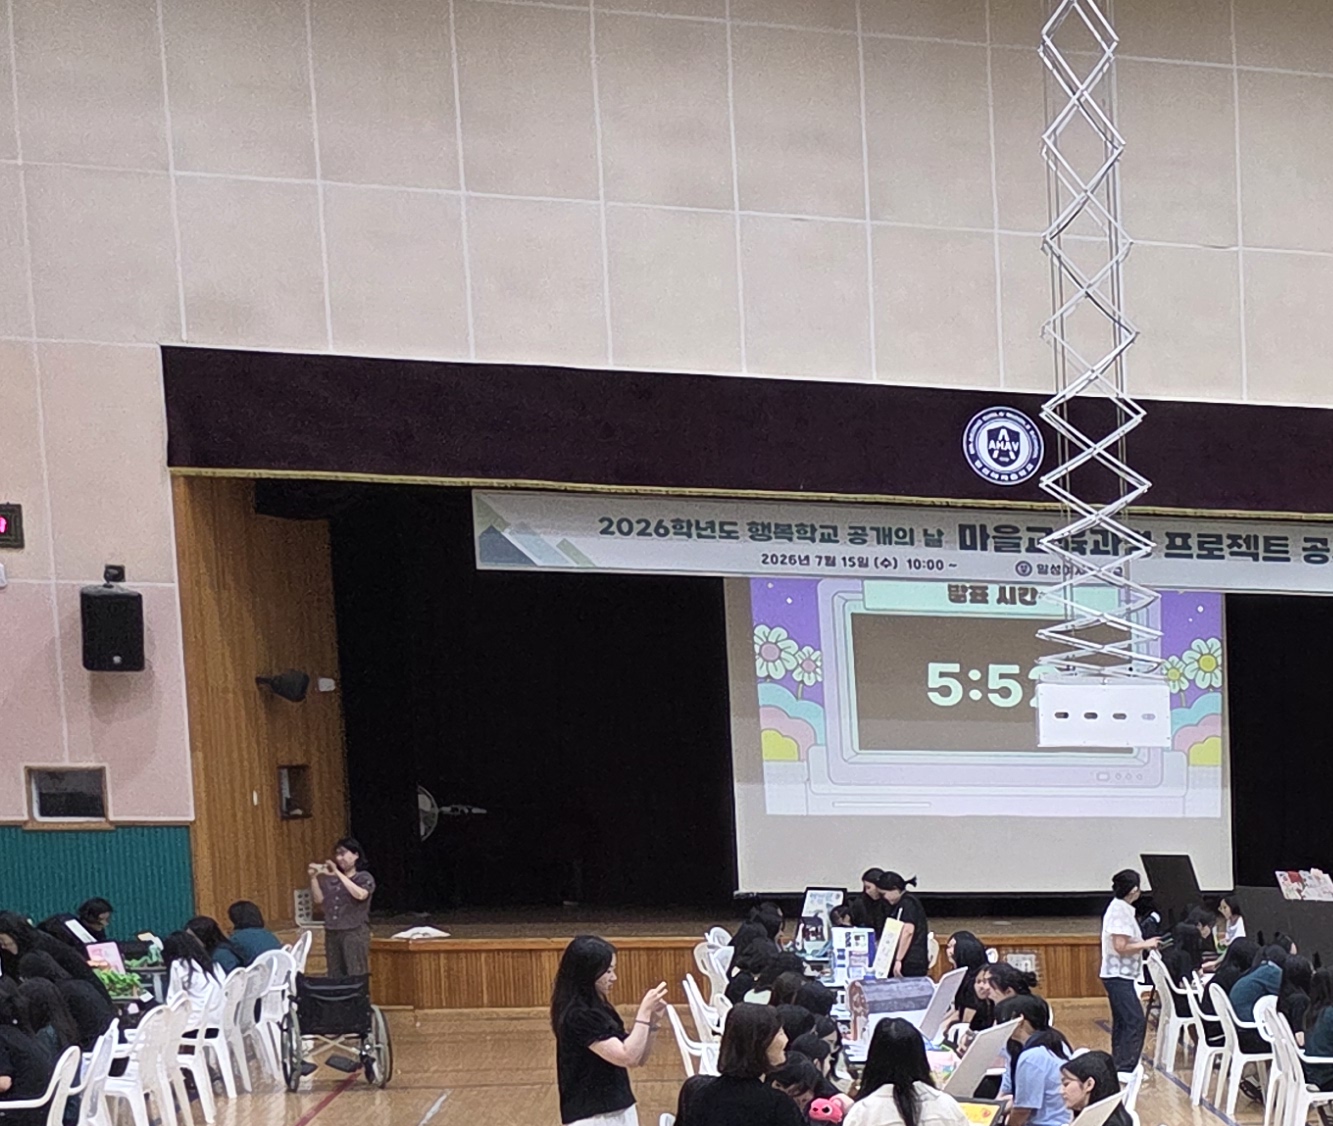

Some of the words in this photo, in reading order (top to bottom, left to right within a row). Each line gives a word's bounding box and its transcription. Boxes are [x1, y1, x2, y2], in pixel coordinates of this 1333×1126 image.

[598, 516, 740, 540] 2026학년도
[746, 521, 840, 543] 행복학교
[847, 525, 915, 546] 공개의
[923, 527, 945, 548] 날
[1164, 531, 1291, 562] 프로젝트
[761, 553, 810, 567] 2026년
[815, 555, 836, 568] 7월
[841, 556, 869, 569] 15일
[874, 557, 898, 570] (수)
[907, 558, 944, 570] 10:00
[948, 583, 989, 604] 발표
[996, 585, 1039, 606] 시간
